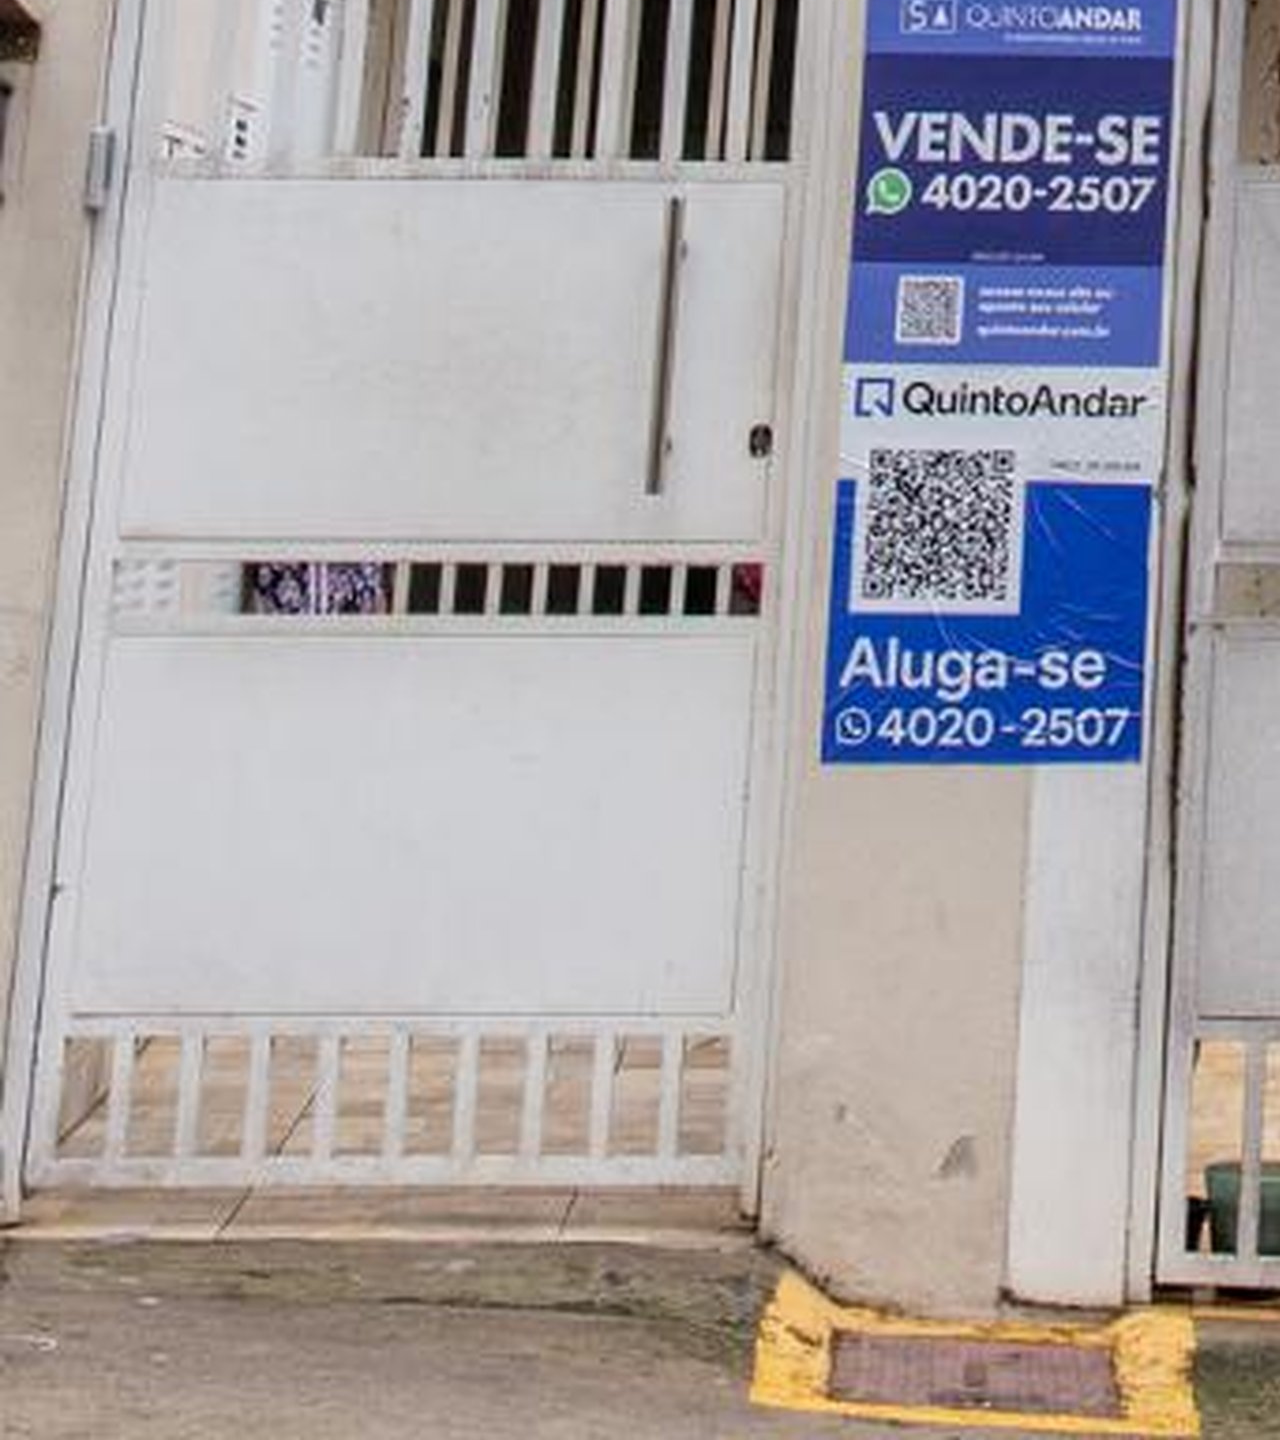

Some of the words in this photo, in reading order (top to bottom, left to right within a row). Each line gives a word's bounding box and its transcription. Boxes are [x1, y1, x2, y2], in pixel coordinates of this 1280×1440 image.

[965, 2, 1142, 31] QUINTOANDAR
[873, 111, 1161, 166] VENDE-SE
[921, 173, 1157, 212] 4020-2507
[902, 382, 1147, 417] QuintoAndar
[839, 636, 1106, 701] Aluga-se
[877, 706, 1130, 746] 4020-2507
